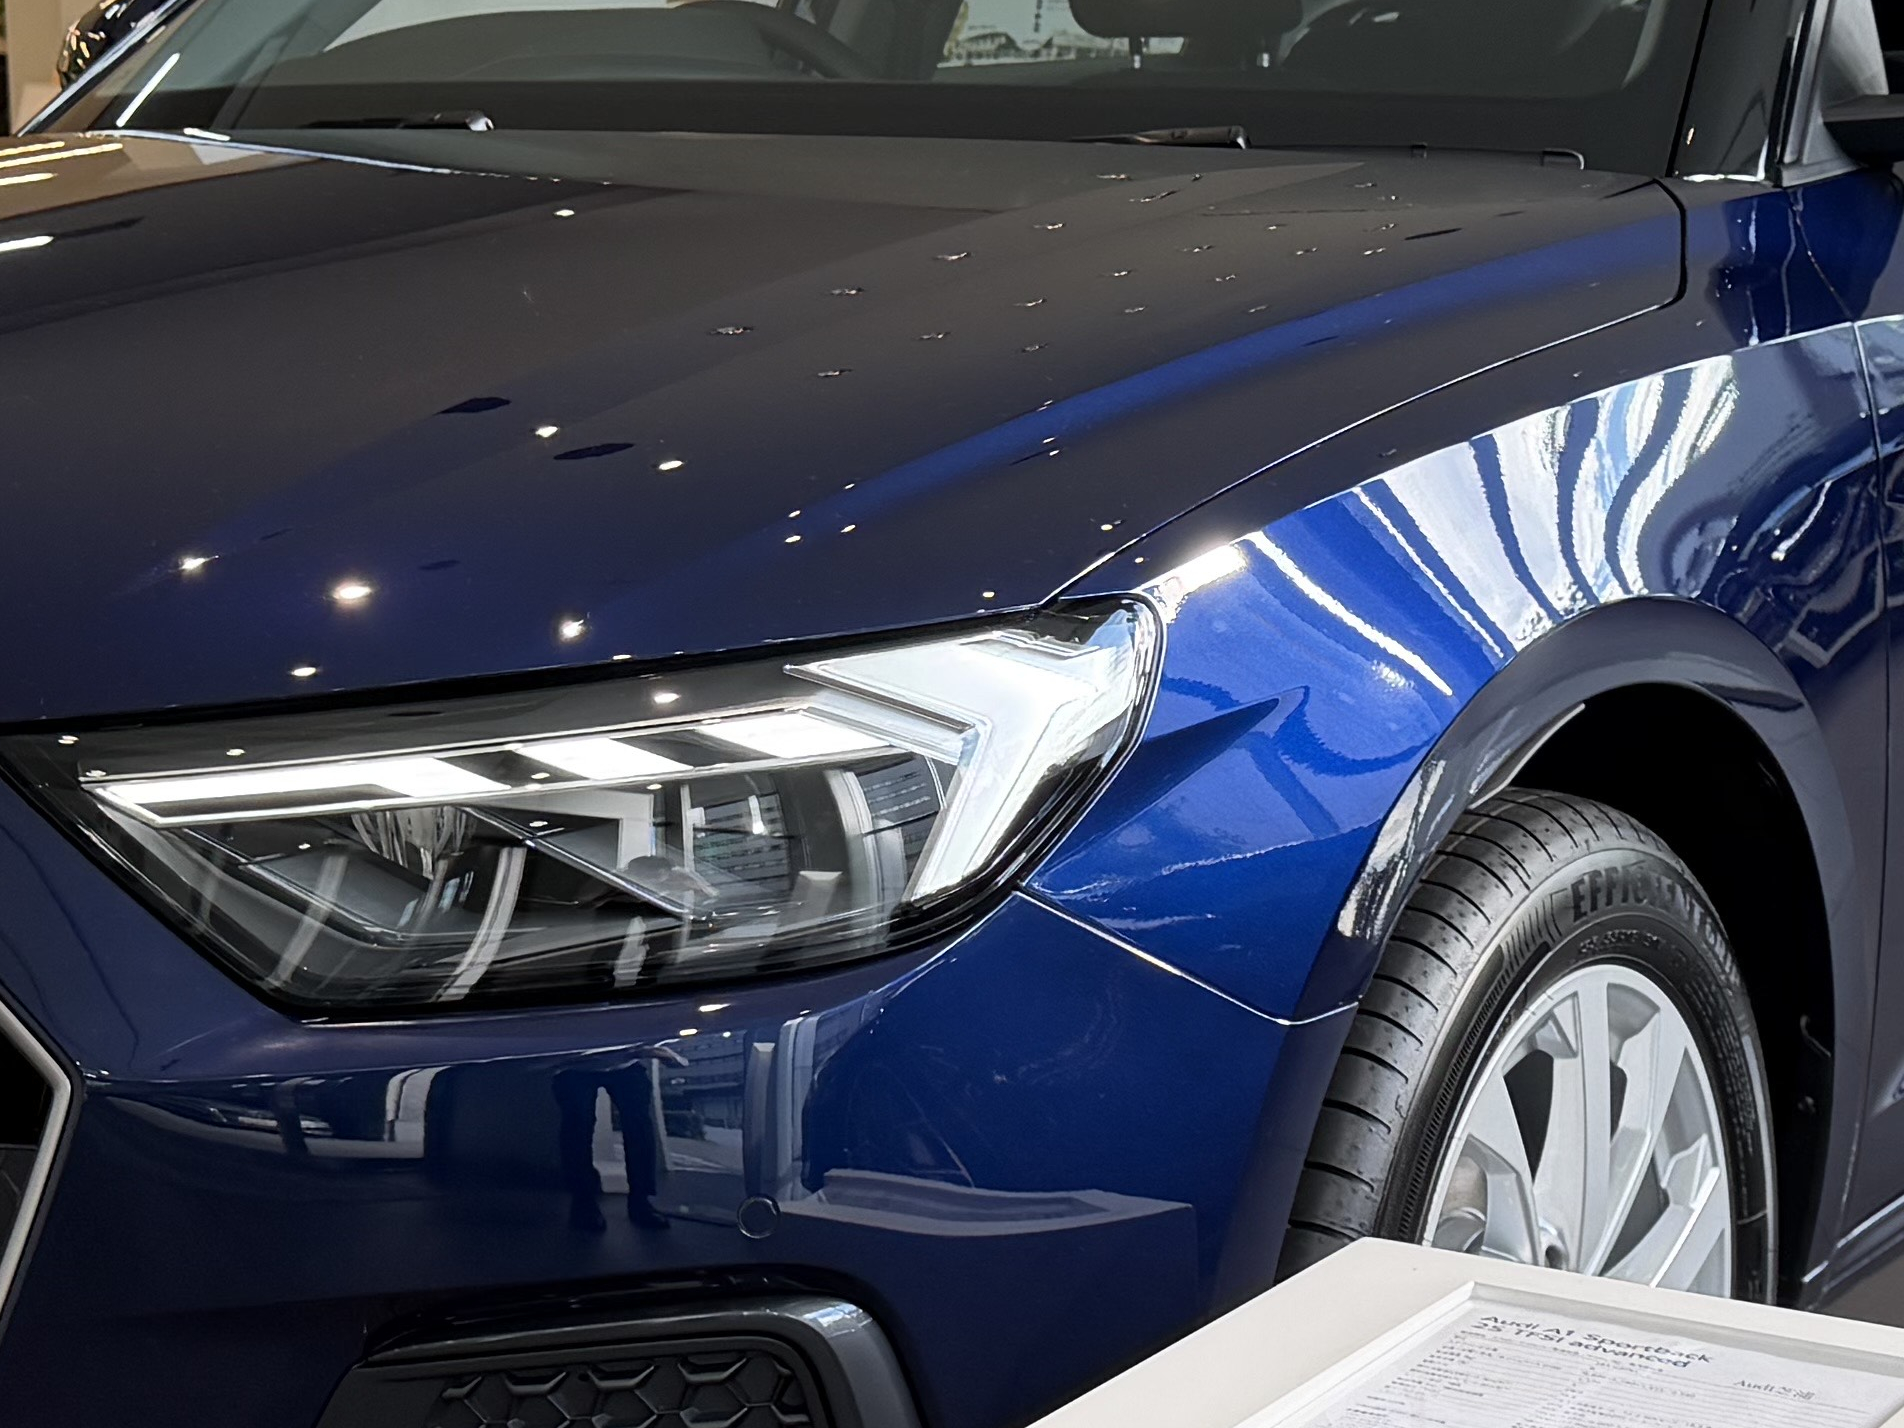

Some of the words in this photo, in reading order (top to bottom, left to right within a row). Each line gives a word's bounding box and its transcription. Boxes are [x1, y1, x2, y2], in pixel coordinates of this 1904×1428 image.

[1481, 1315, 1539, 1330] Audi
[1543, 1327, 1575, 1336] A1
[1583, 1333, 1712, 1363] Sportback
[1514, 1329, 1565, 1343] TFSI
[1569, 1341, 1691, 1369] advanced
